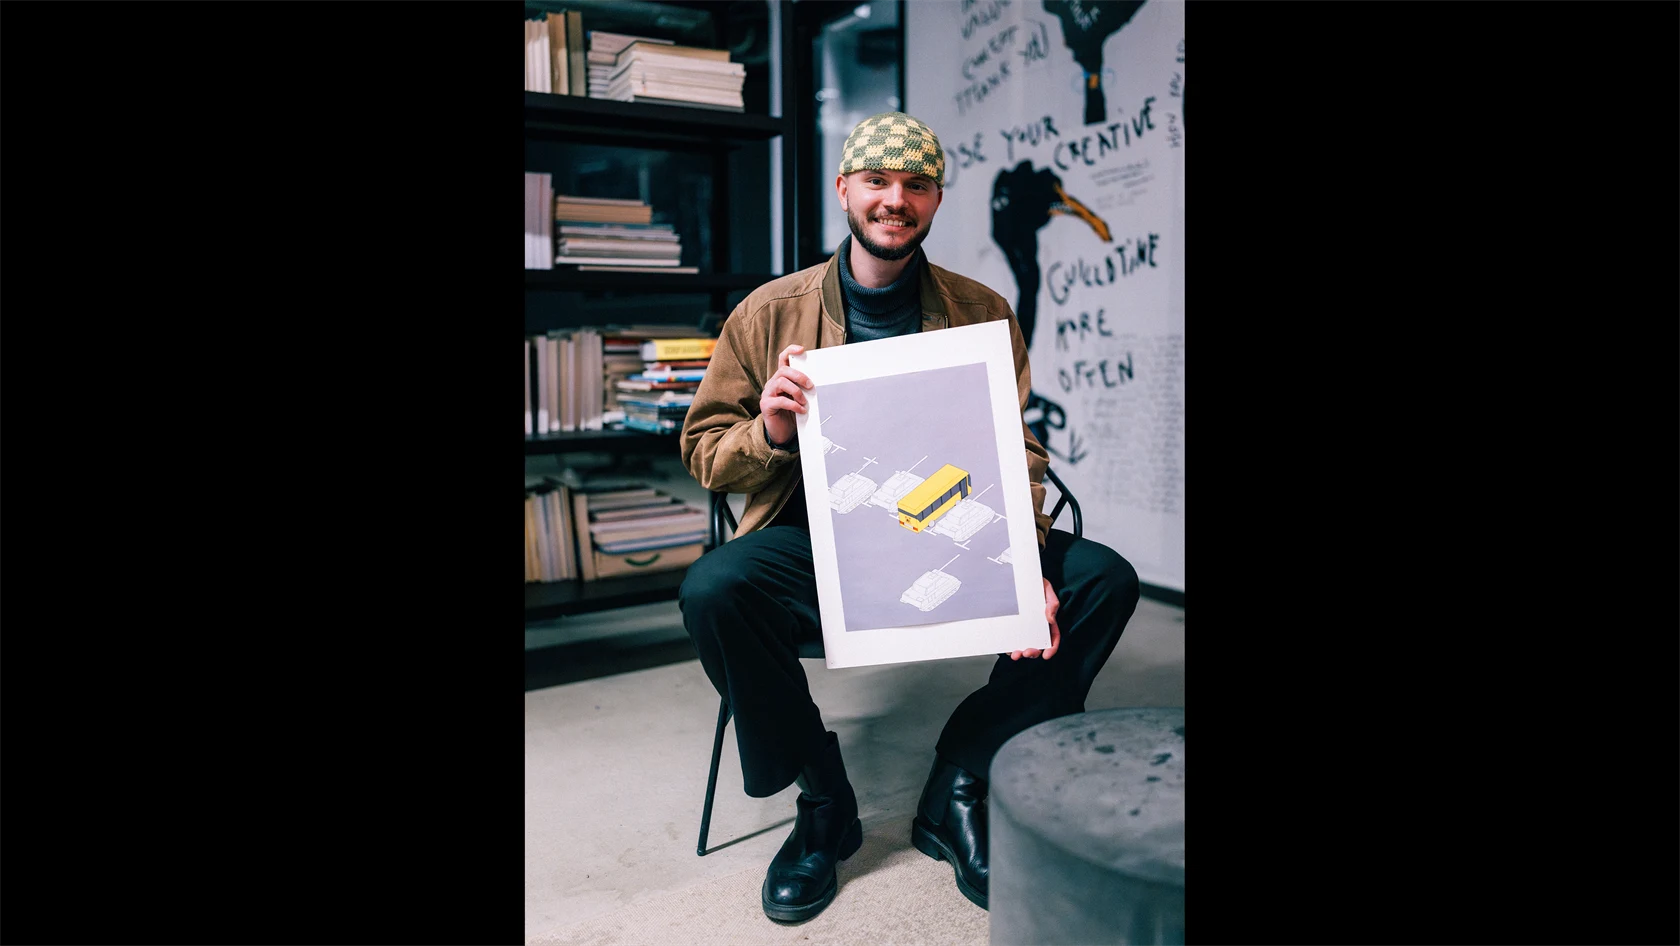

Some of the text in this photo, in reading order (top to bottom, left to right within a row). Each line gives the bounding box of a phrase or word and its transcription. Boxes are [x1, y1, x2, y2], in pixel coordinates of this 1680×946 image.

[1000, 115, 1060, 161] YOUR
[1053, 96, 1157, 170] CREATIVE
[1058, 352, 1134, 393] OFTEN
